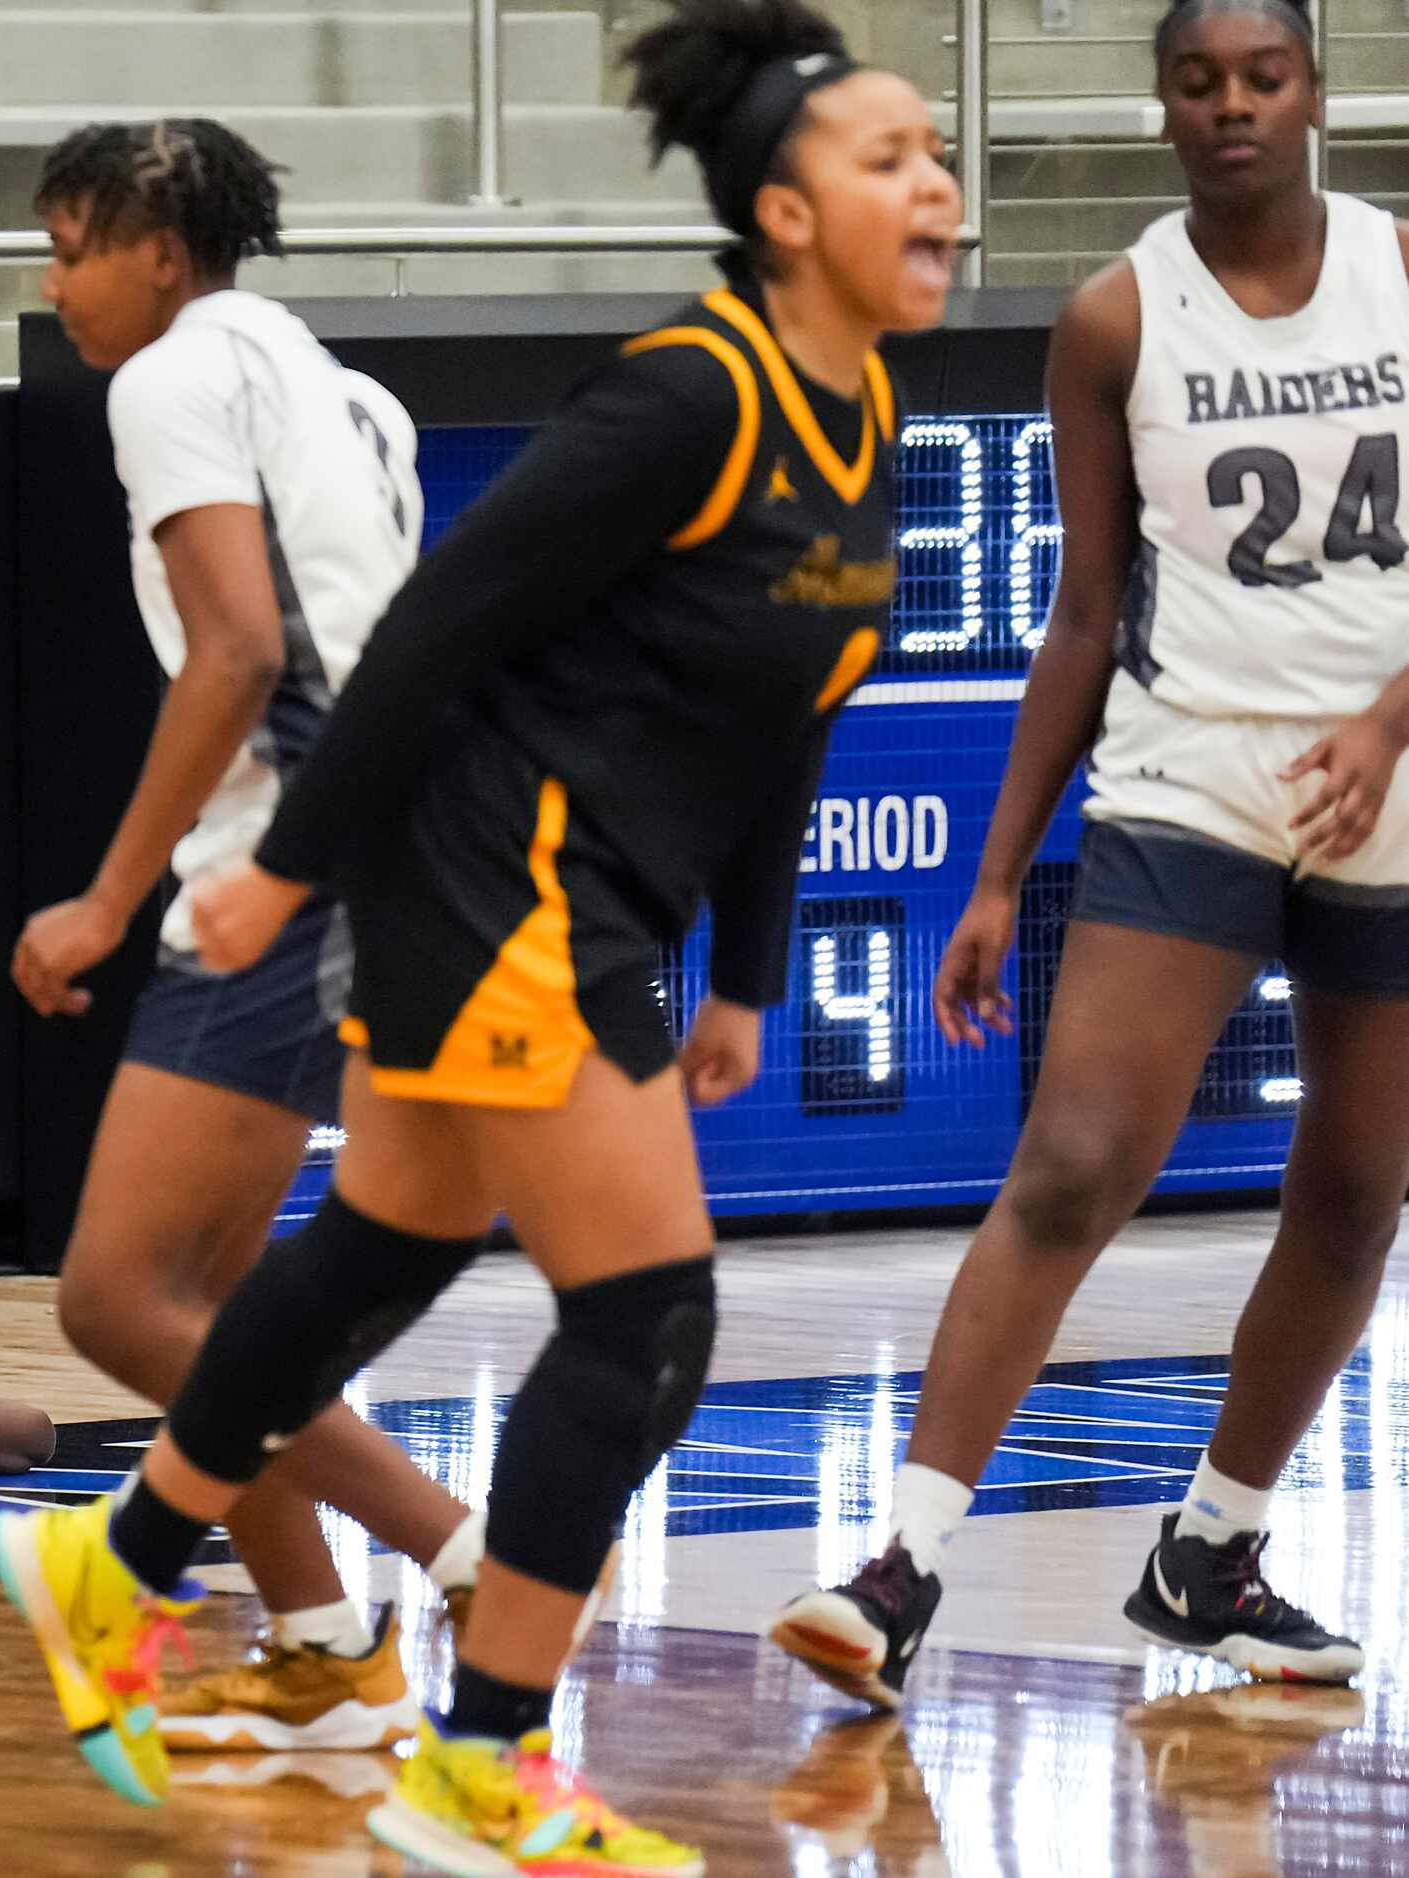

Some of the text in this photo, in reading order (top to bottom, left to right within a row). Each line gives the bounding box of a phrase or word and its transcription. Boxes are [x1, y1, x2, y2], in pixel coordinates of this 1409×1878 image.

[1184, 352, 1405, 424] RAIDERS
[1206, 432, 1409, 588] 24
[812, 930, 891, 1082] 4
